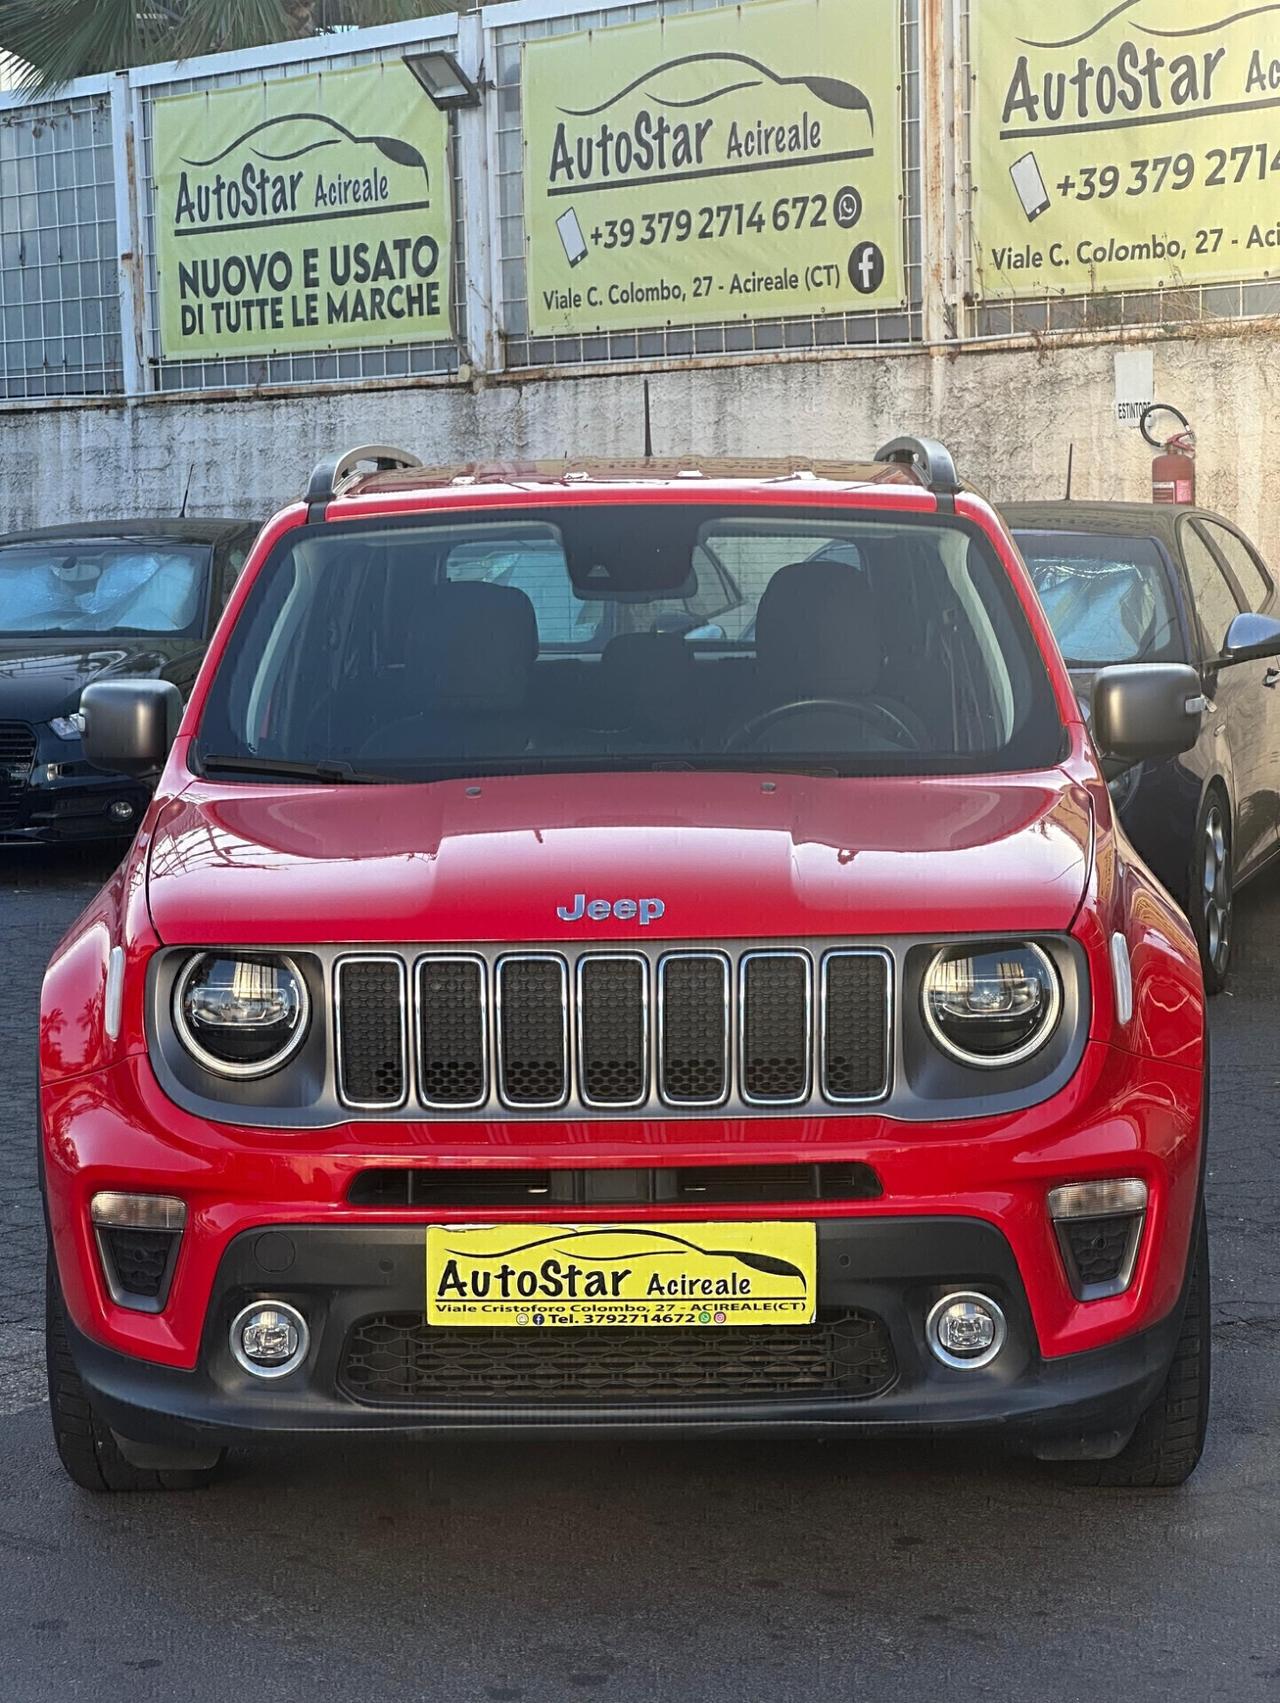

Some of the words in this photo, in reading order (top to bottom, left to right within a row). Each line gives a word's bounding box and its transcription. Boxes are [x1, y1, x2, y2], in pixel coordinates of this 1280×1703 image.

[1002, 40, 1226, 124] AutoStar
[549, 110, 714, 183] AutoStar
[726, 110, 822, 160] Acireale
[175, 162, 304, 224] AutoStar
[314, 167, 389, 208] Acireale
[1056, 165, 1120, 201] +39
[1125, 153, 1195, 196] 379
[590, 218, 635, 250] +39
[640, 209, 692, 247] 379
[698, 201, 766, 240] 2714
[771, 193, 828, 231] 672
[178, 250, 293, 299] NUOVO
[302, 247, 320, 289] E
[329, 235, 440, 287] USATO
[991, 244, 1043, 270] Viale
[1049, 243, 1069, 267] C.
[1077, 234, 1186, 265] Colombo,
[1195, 228, 1224, 254] 27
[181, 304, 204, 336] DI
[211, 296, 284, 334] TUTTE
[291, 293, 319, 328] LE
[326, 281, 441, 325] MARCHE
[542, 287, 582, 311] Viale
[586, 286, 603, 308] C.
[608, 277, 687, 305] Colombo,
[692, 276, 713, 298] 27
[729, 268, 799, 295] Acireale
[804, 264, 841, 291] (CT)
[556, 893, 665, 926] Jeep
[437, 1259, 632, 1298] AutoStar
[647, 1272, 751, 1296] Acireale
[435, 1304, 477, 1313] Viale
[482, 1304, 566, 1313] Cristoforo
[570, 1303, 650, 1314] Colombo,
[655, 1303, 675, 1312] 27
[690, 1302, 806, 1312] ACIREALE(CT)
[548, 1313, 579, 1324] Tel.
[584, 1313, 696, 1324] 3792714672
